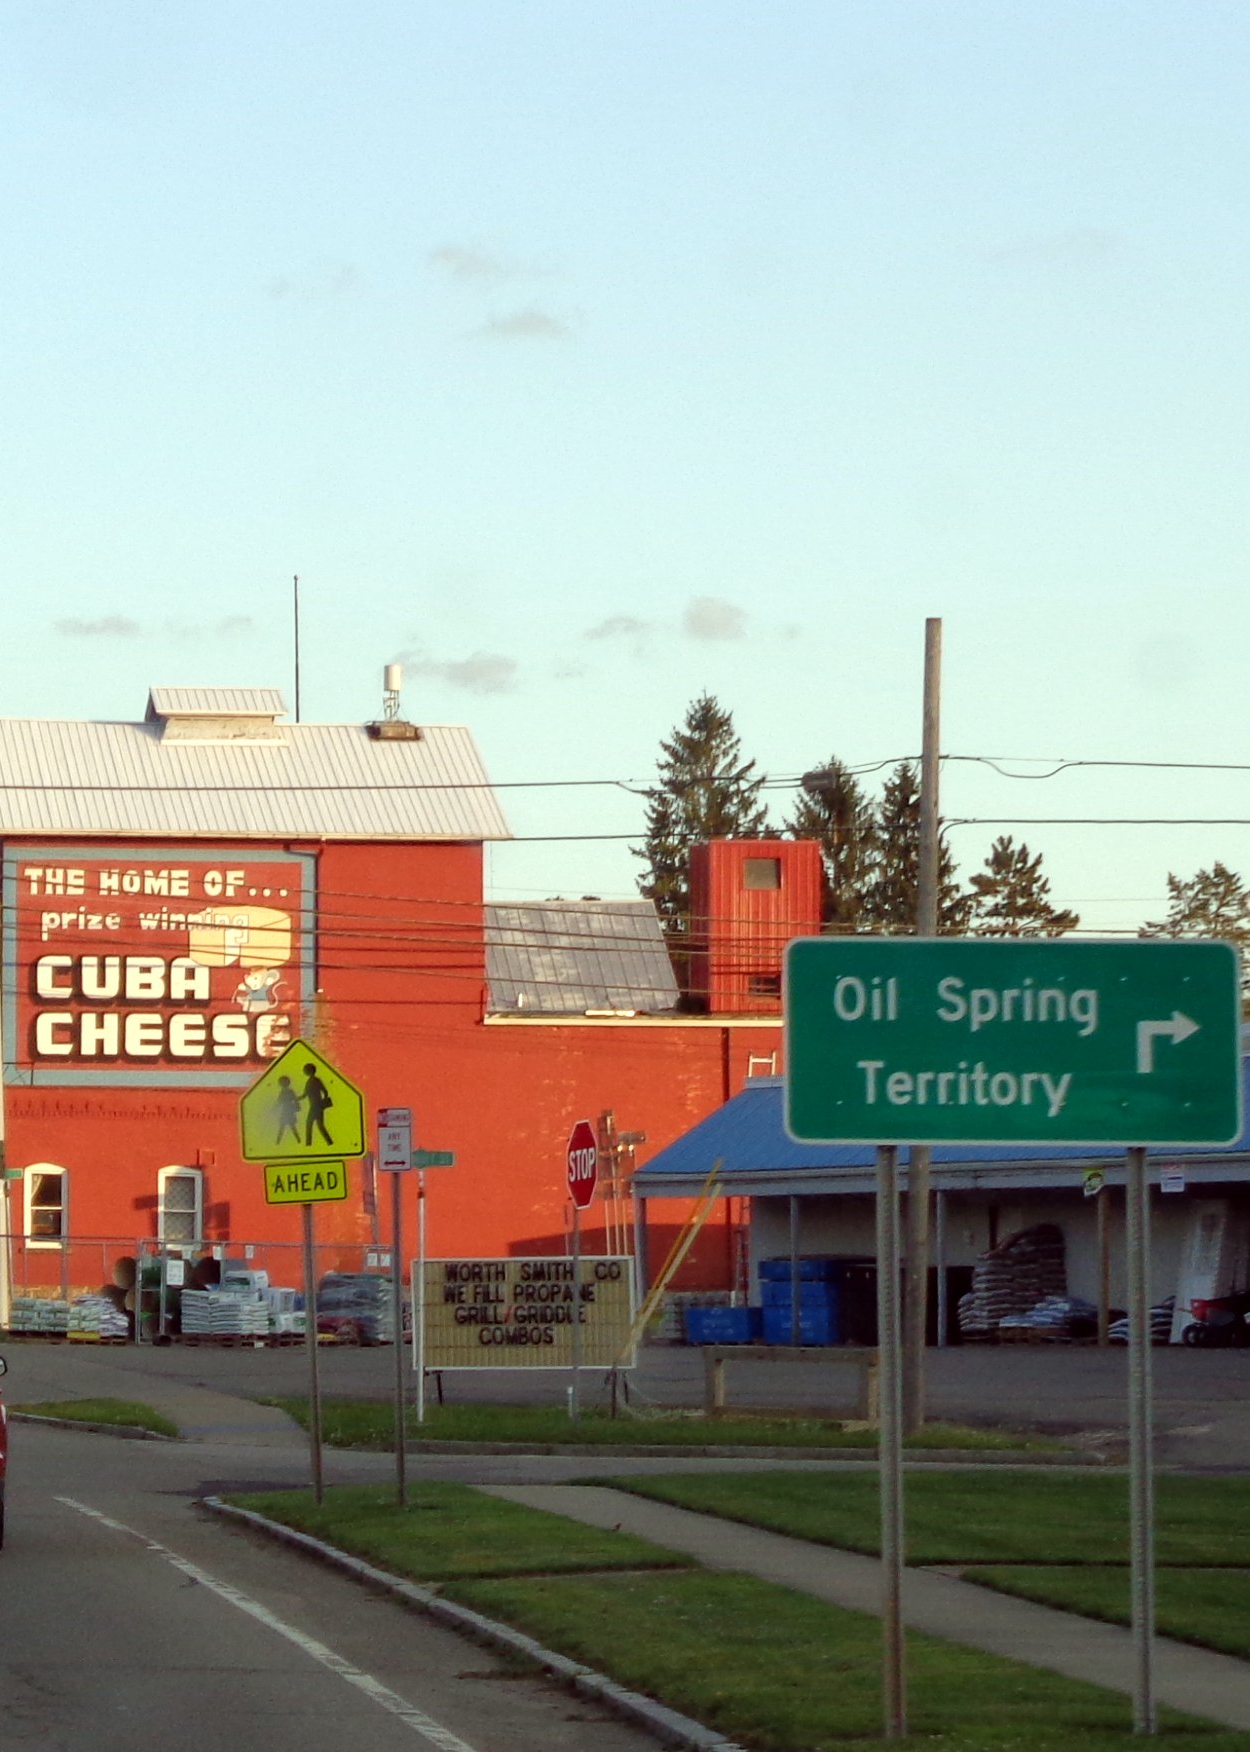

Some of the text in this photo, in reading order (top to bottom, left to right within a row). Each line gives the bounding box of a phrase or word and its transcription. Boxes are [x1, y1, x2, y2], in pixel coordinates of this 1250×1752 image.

[24, 867, 288, 898] THE HOME OF...
[40, 905, 250, 945] prize winning
[35, 954, 211, 1001] CUBA
[833, 975, 1099, 1038] Oil Spring
[35, 1011, 291, 1058] CHEESE
[856, 1059, 1073, 1117] Territory
[569, 1147, 595, 1182] STOP
[273, 1171, 339, 1194] AHEAD
[444, 1261, 621, 1282] WORTH SMITH CO
[443, 1284, 466, 1303] WE
[473, 1284, 505, 1303] FILL
[478, 1326, 555, 1346] COMBOS
